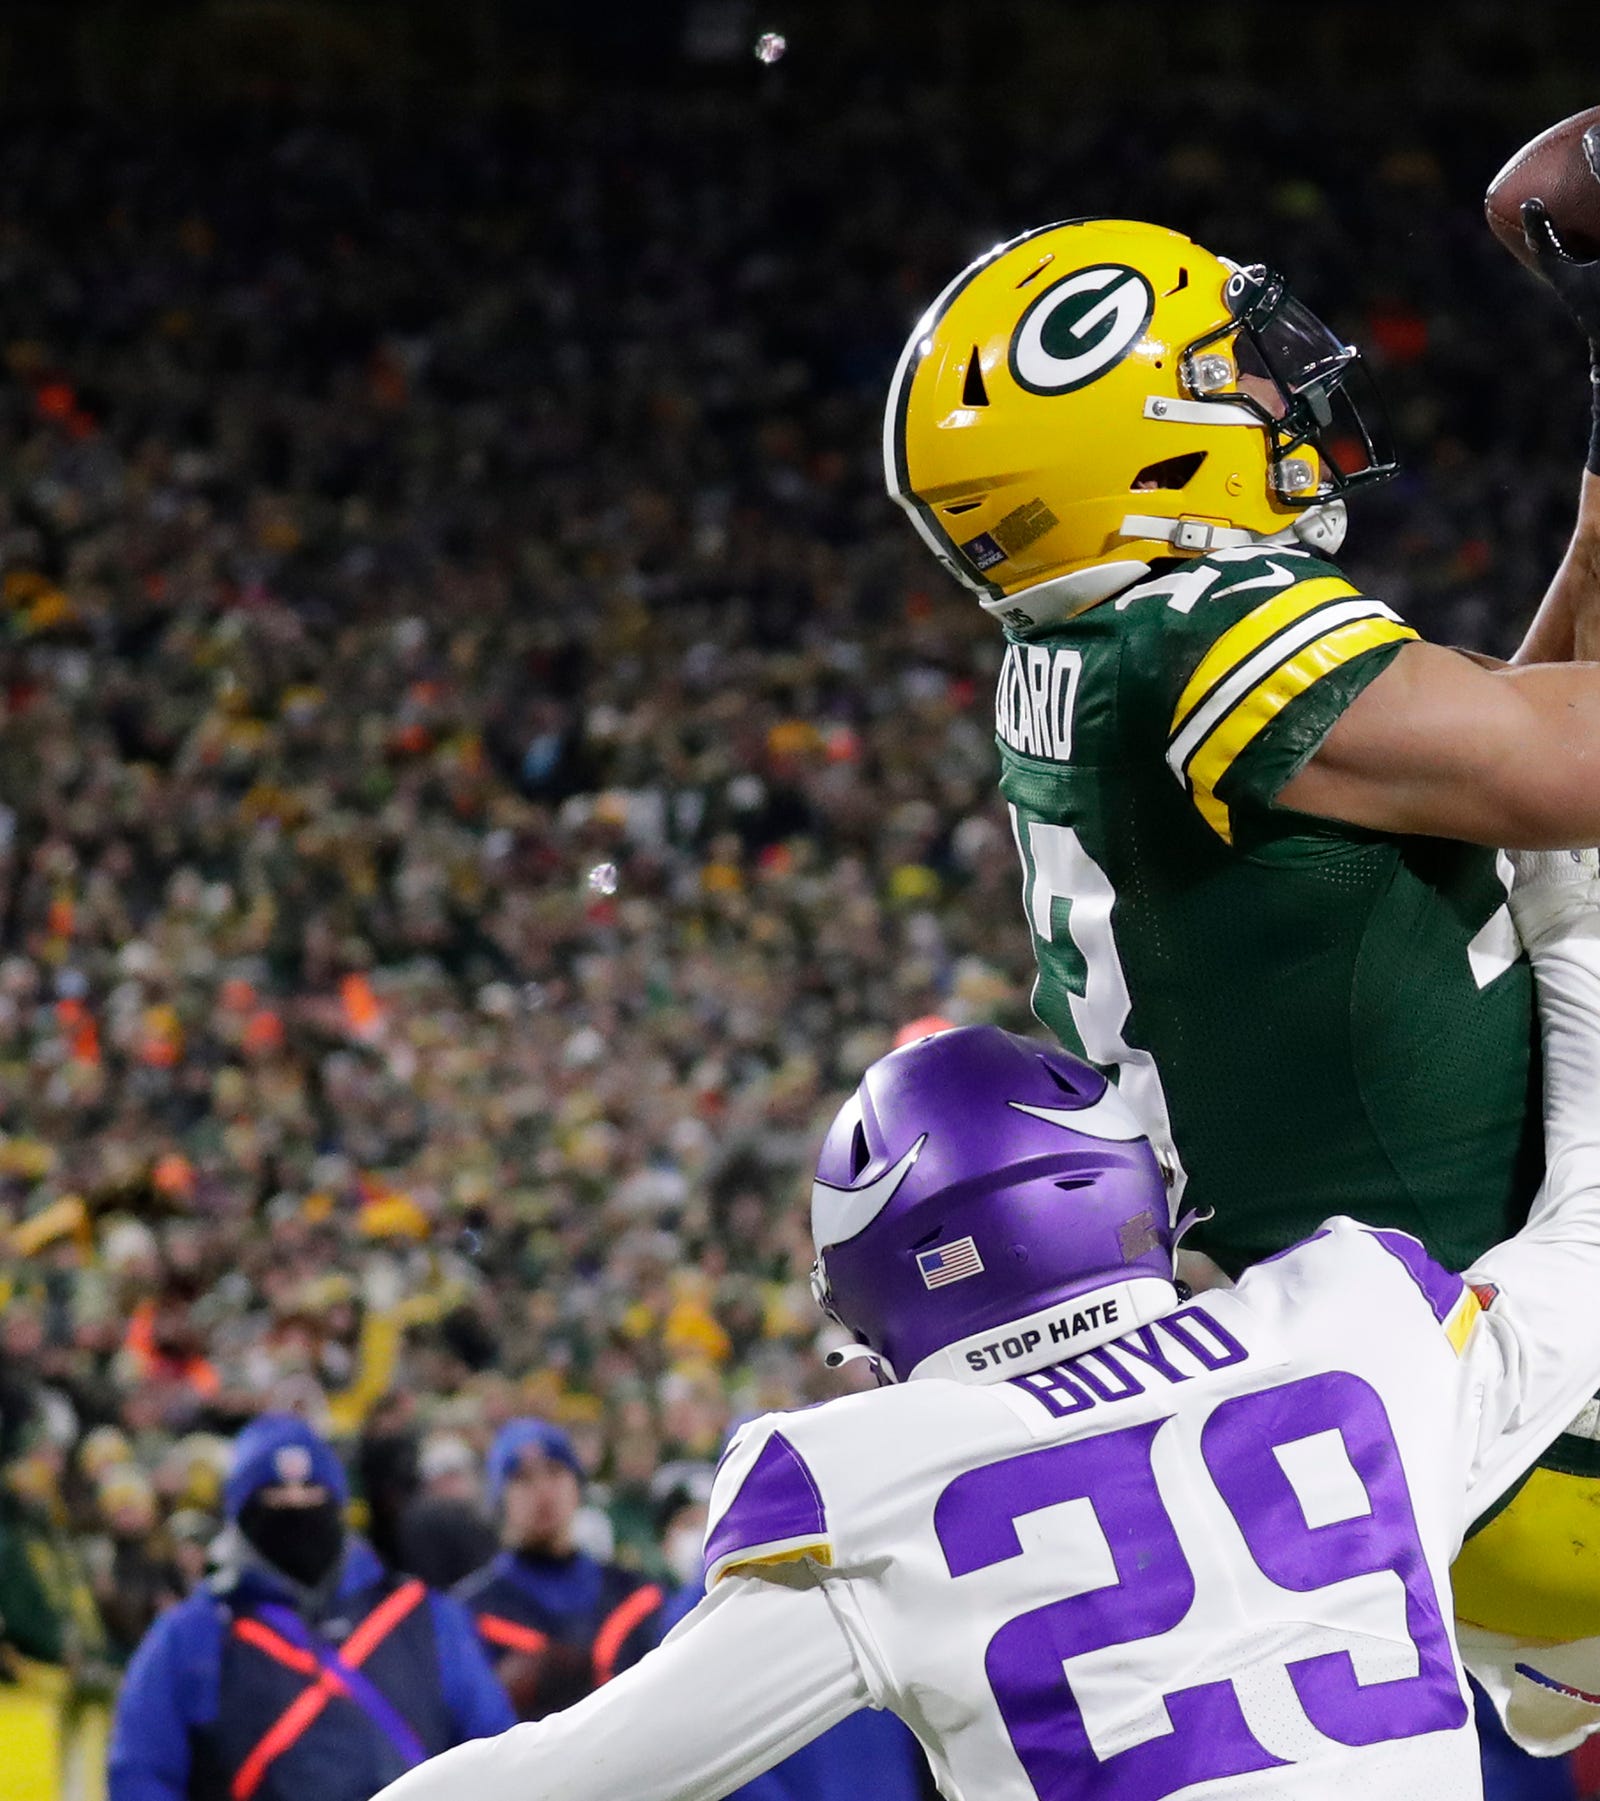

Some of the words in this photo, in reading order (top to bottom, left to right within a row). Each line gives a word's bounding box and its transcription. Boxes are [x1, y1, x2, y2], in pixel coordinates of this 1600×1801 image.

[1014, 267, 1150, 390] G
[965, 1328, 1042, 1373] STOP
[1047, 1299, 1120, 1344] HATE
[1004, 1305, 1250, 1418] BOYD
[933, 1370, 1468, 1801] 29
